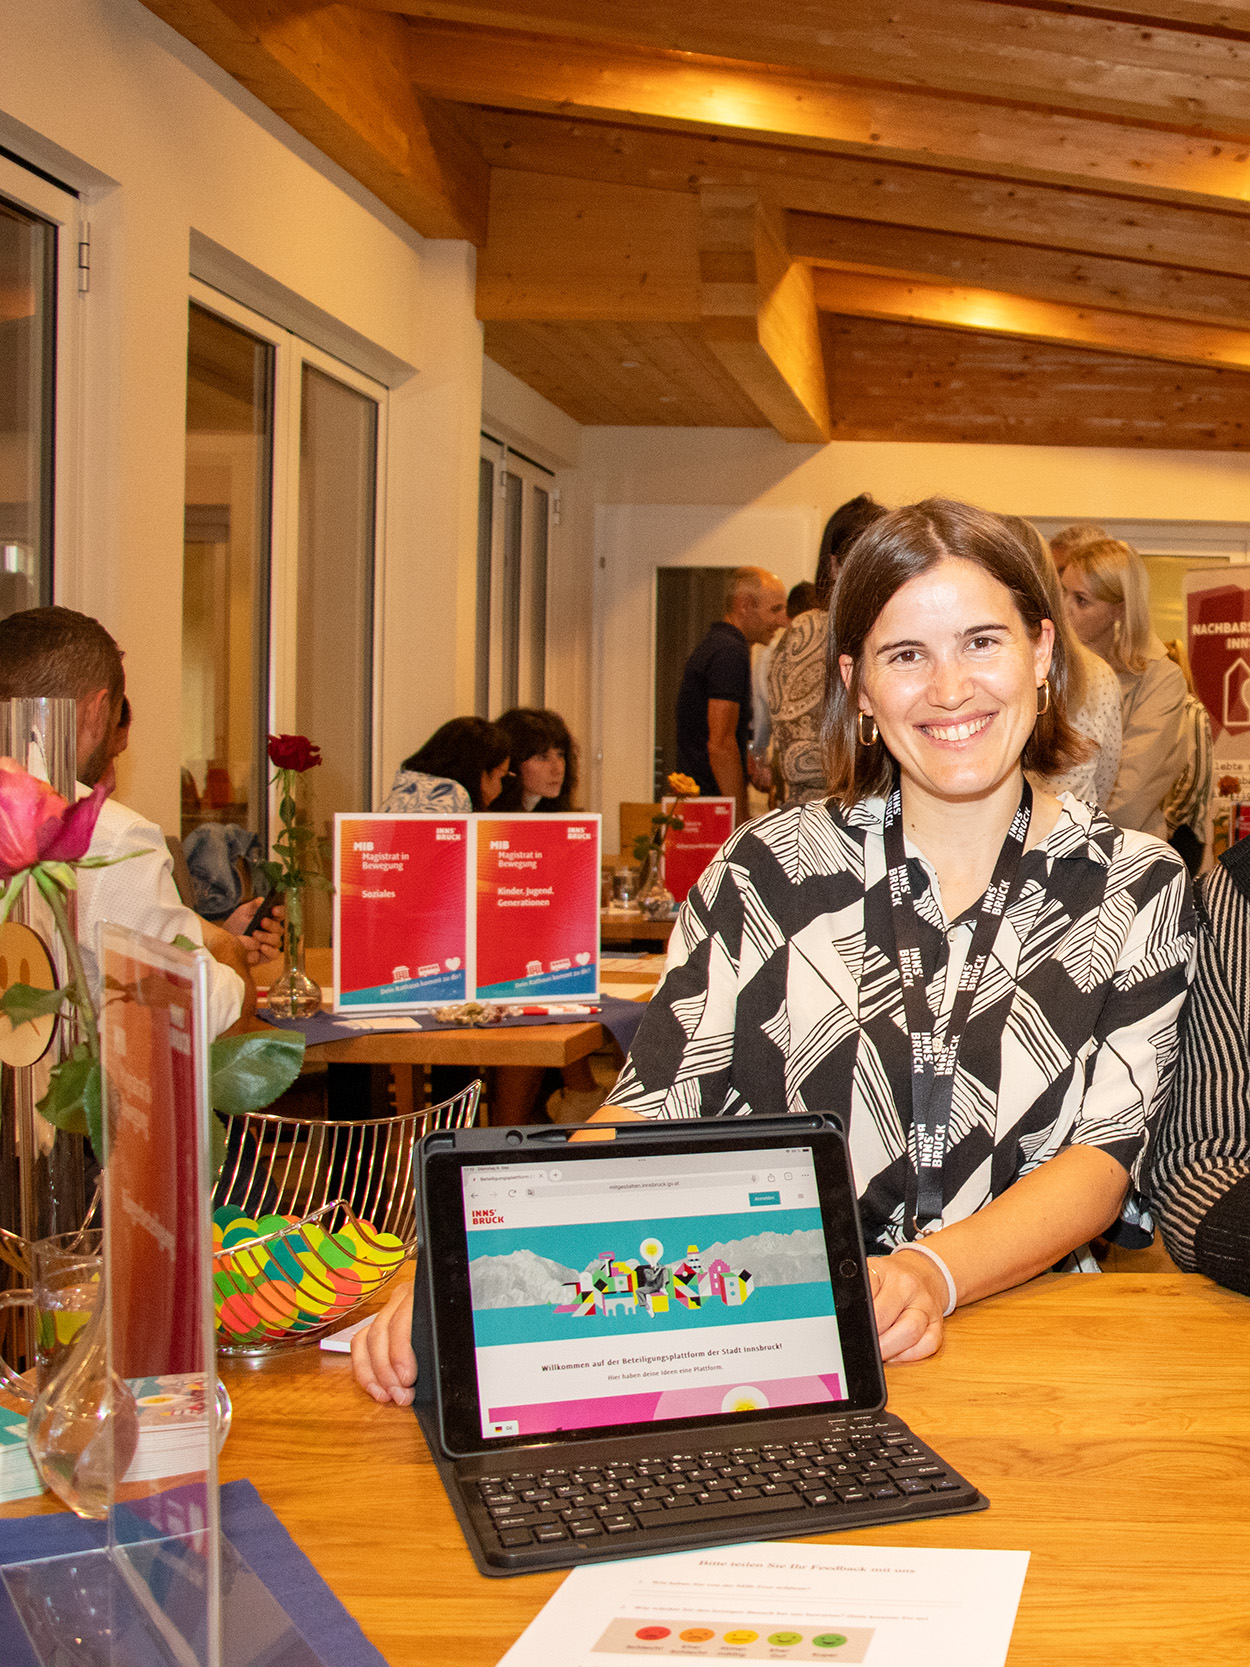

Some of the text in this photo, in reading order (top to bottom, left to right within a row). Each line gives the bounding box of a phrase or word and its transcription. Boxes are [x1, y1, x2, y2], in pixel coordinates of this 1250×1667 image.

[1214, 762, 1244, 770] lebte
[893, 790, 901, 815] INNS'
[1008, 808, 1022, 838] INNS'
[1015, 807, 1031, 843] BRUCK
[353, 842, 374, 851] MIB
[362, 852, 410, 862] Magistrat in
[490, 841, 510, 850] MIB
[498, 851, 533, 861] Magistrat
[362, 861, 404, 871] Bewegung
[498, 860, 537, 869] Bewegung
[898, 864, 911, 895] INNS'
[362, 889, 396, 899] Soziales
[889, 868, 902, 906] BRUCK
[982, 883, 998, 913] INNS'
[991, 880, 1011, 916] BRUCK
[498, 898, 550, 907] Generationen
[899, 949, 914, 987] BRUCK
[910, 948, 924, 978] INNS'
[958, 962, 974, 991] INNS'
[966, 954, 987, 991] BRUCK
[911, 1032, 924, 1073] BRUCK
[921, 1032, 934, 1064] INNS'
[936, 1044, 950, 1076] INNS'
[945, 1034, 960, 1075] BRUCK
[920, 1133, 934, 1167] INNS'
[932, 1124, 946, 1168] BRUCK
[473, 1216, 504, 1224] BRUCK
[542, 1362, 590, 1372] Willkommen
[592, 1360, 605, 1368] auf
[607, 1358, 620, 1366] der
[622, 1350, 705, 1364] Beteiligungsplattform
[722, 1347, 741, 1356] Stadt
[744, 1343, 782, 1353] Innsbruck!
[694, 1364, 723, 1372] Plattform.
